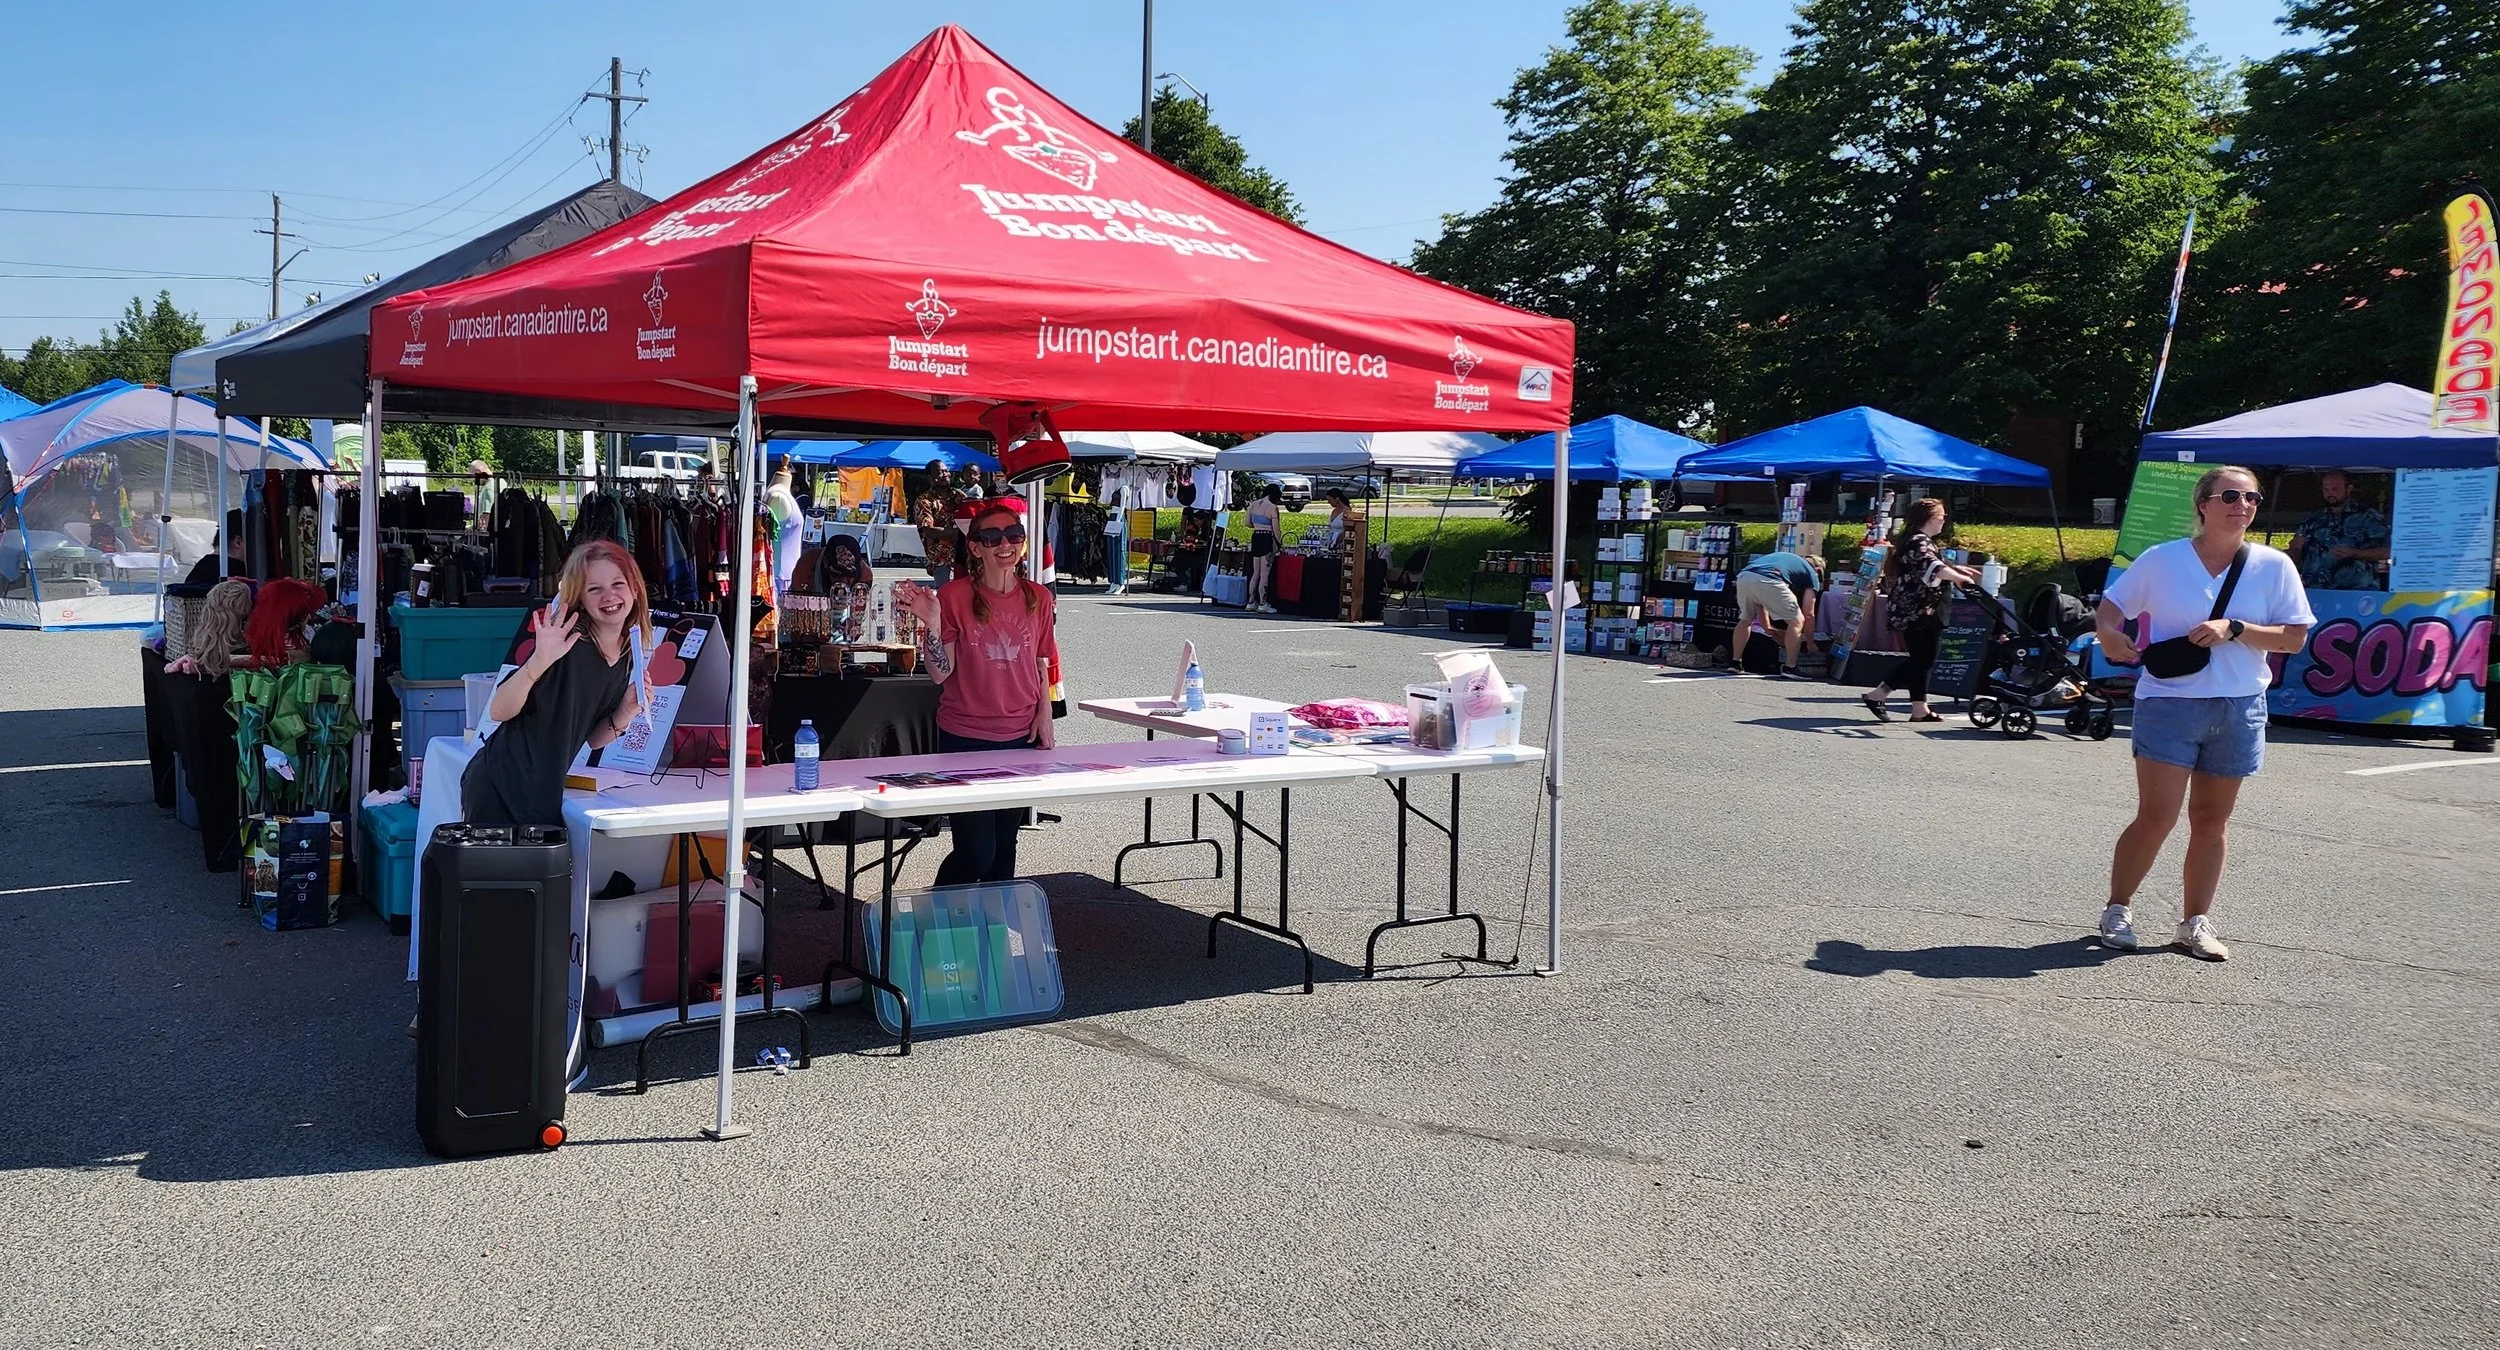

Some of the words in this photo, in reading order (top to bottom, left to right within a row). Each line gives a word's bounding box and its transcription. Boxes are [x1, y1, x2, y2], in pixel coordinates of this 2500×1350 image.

[960, 184, 1231, 235] Jumpstart
[989, 213, 1107, 241] Bon
[1104, 219, 1269, 263] départ
[446, 302, 608, 347] jumpstart.canadiantire.ca
[637, 325, 676, 343] Jumpstart
[637, 345, 651, 360] Bon
[651, 344, 676, 362] départ
[888, 336, 969, 358] Jumpstart
[1037, 317, 1388, 379] jumpstart.canadiantire.ca
[888, 354, 918, 371] Bon
[918, 358, 968, 377] départ
[1435, 381, 1489, 397] Jumpstart
[1434, 396, 1456, 410] Bon
[1455, 397, 1489, 414] départ
[2305, 618, 2494, 696] SODA
